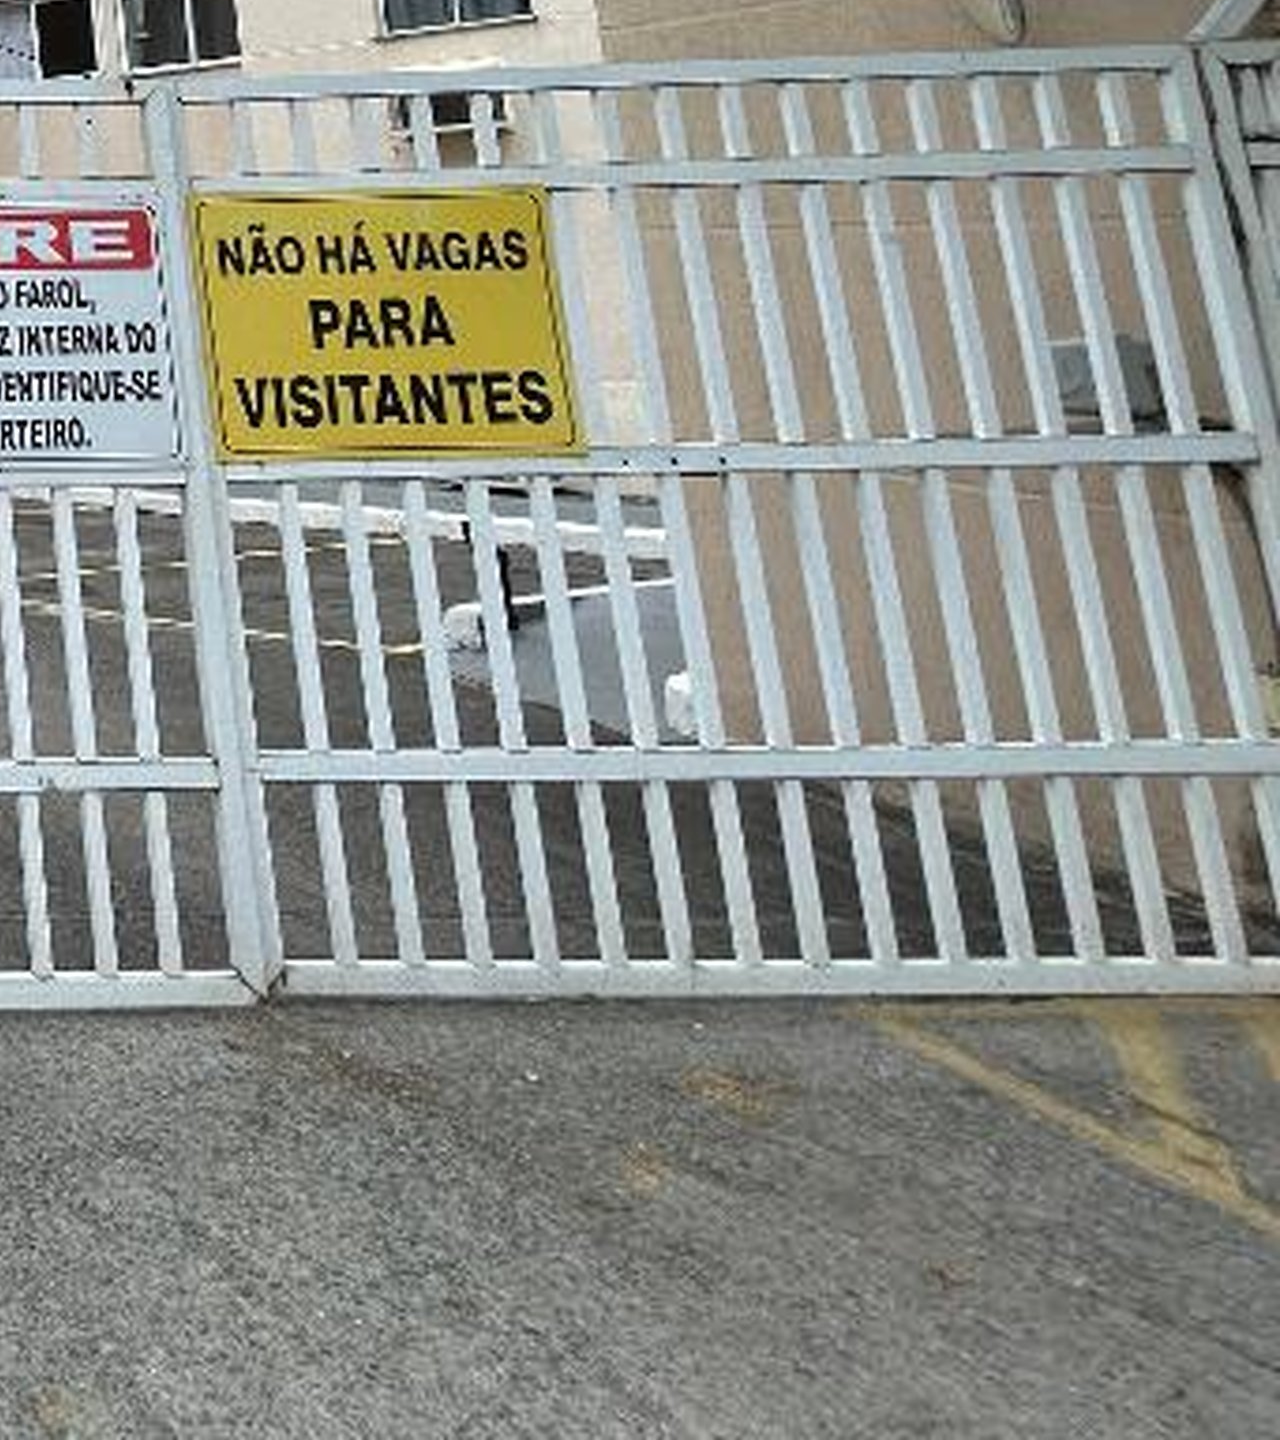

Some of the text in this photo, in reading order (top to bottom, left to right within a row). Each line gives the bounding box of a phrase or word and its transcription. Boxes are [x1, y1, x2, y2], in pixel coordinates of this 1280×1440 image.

[218, 221, 528, 275] NÃO HÁ VAGAS
[16, 279, 96, 315] FAROL,
[308, 296, 455, 348] PARA
[19, 325, 117, 356] INTERNA
[125, 323, 156, 353] DO
[234, 371, 553, 428] VISITANTES
